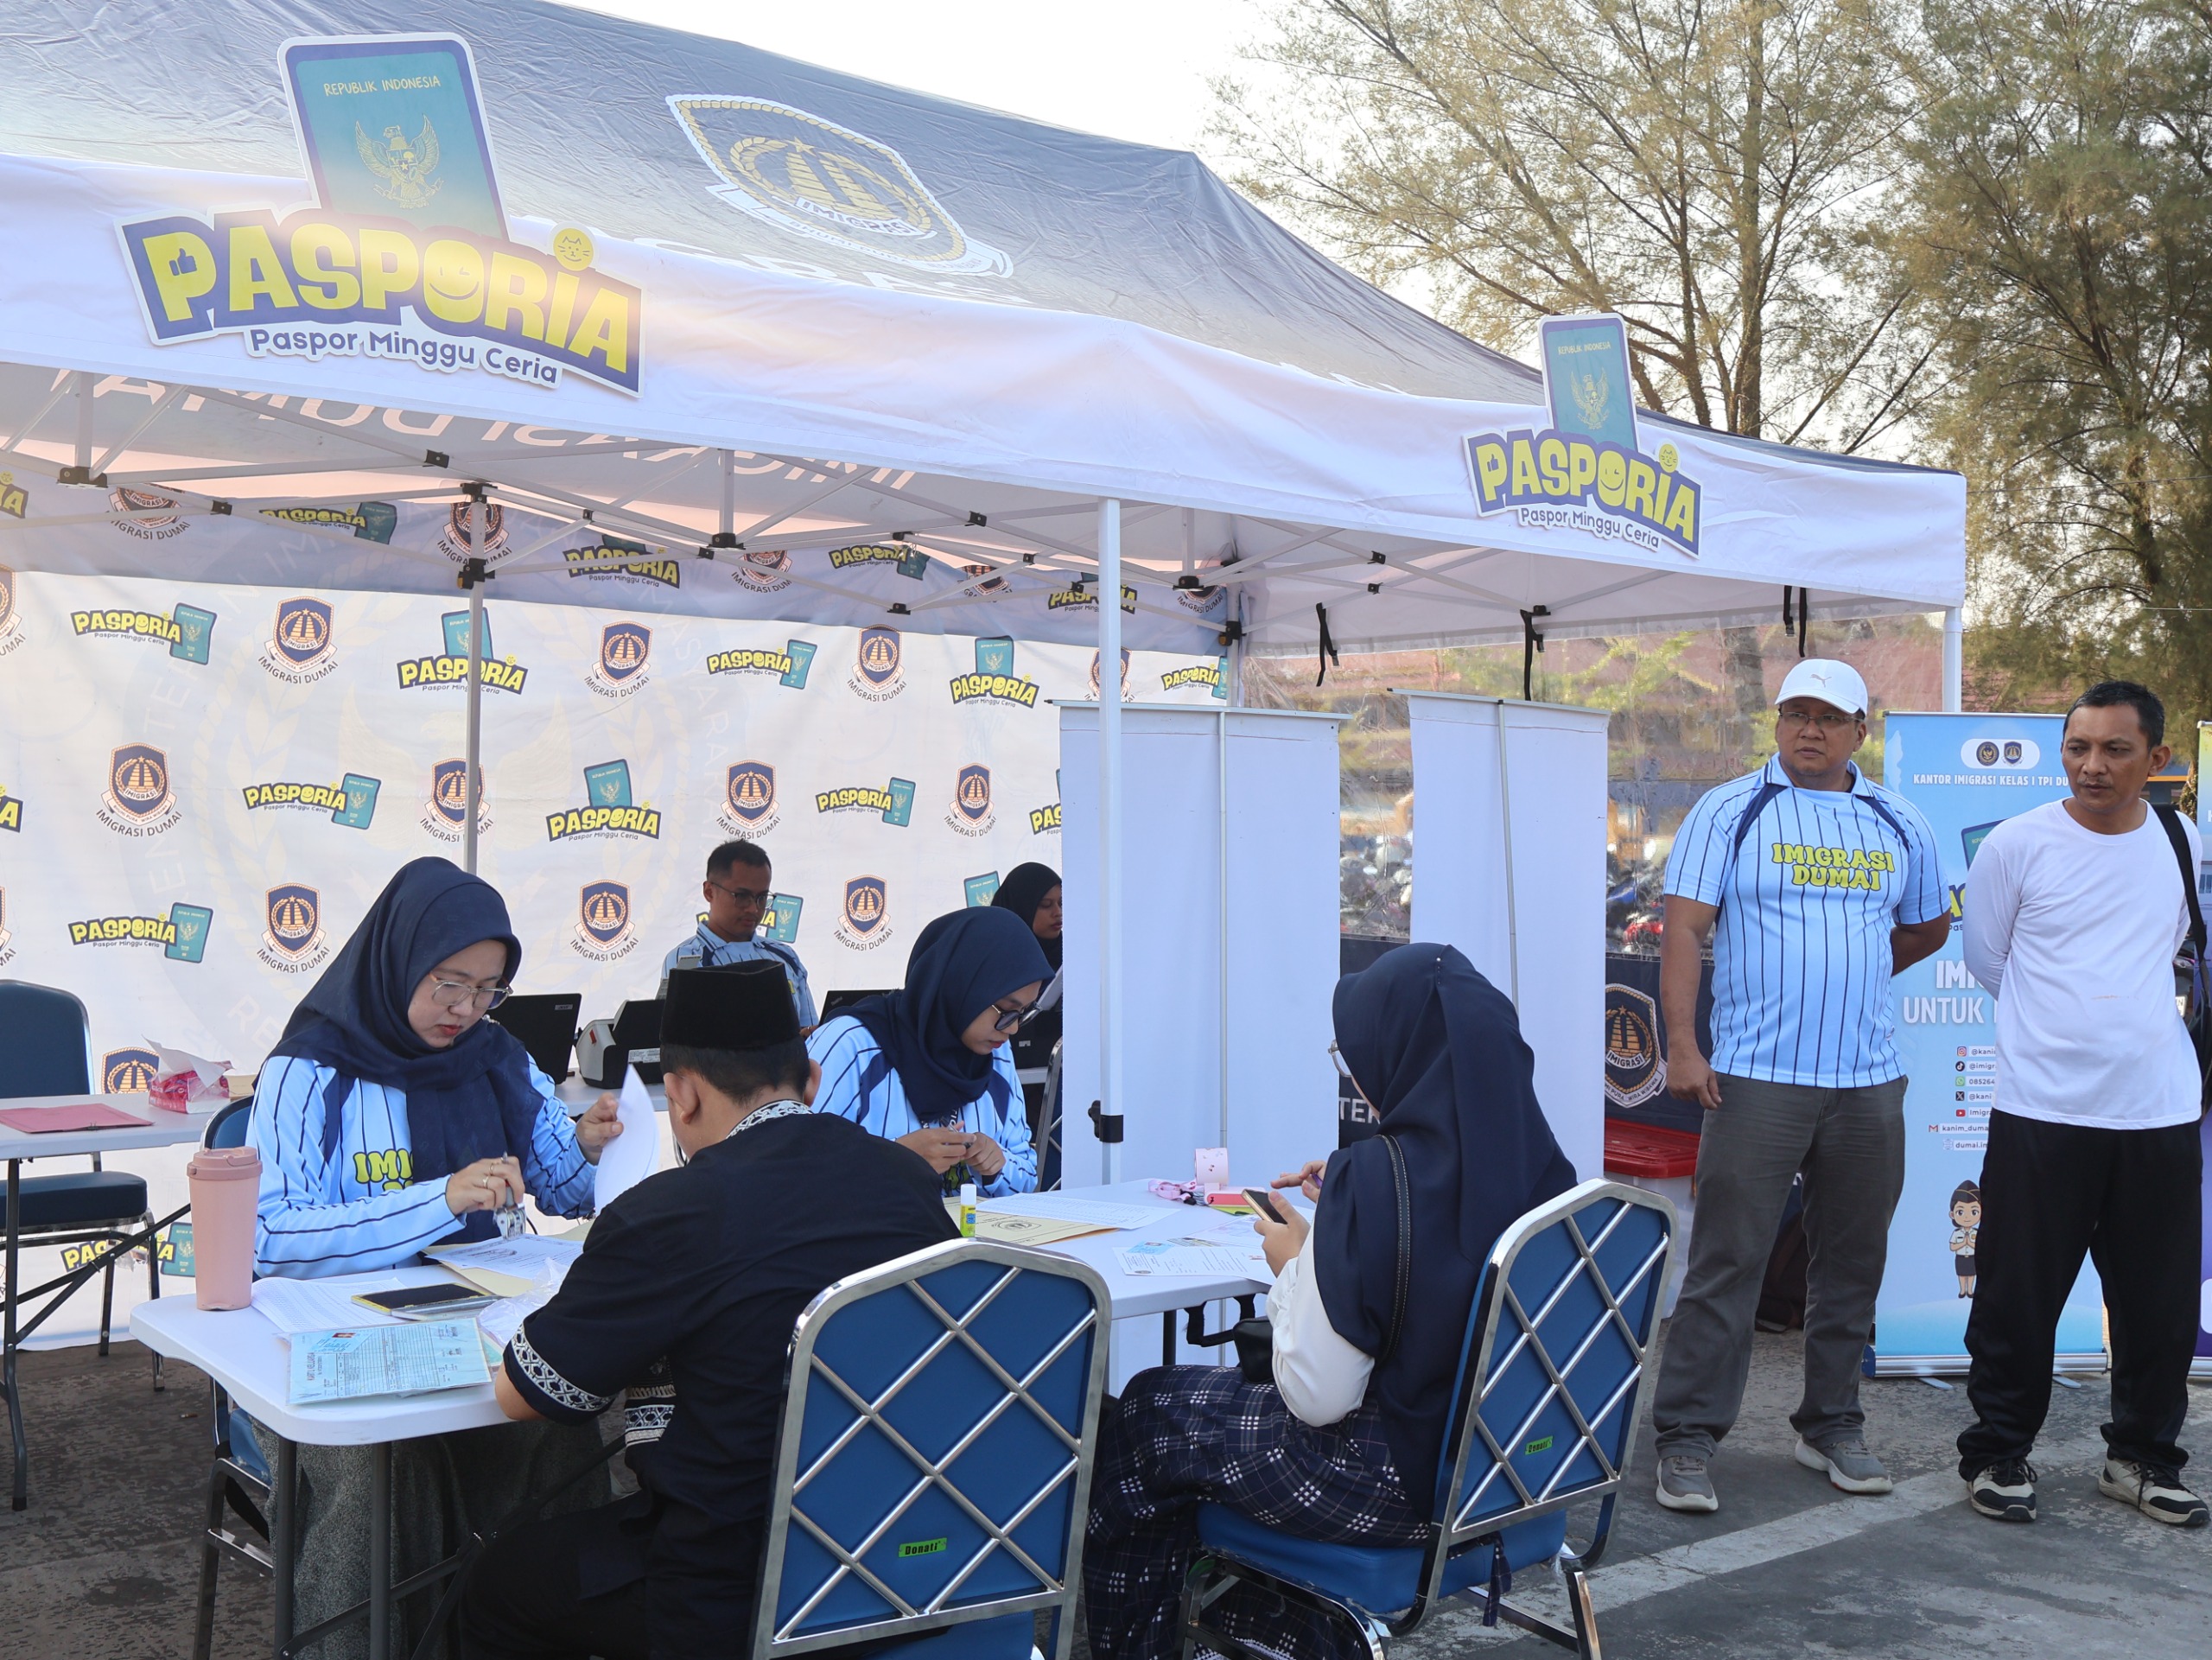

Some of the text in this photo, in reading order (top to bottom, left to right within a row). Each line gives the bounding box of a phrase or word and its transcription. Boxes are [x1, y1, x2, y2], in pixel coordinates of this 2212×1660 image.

[323, 74, 442, 97] REPUBLIK INDONESIA
[142, 223, 630, 374] PASPORIA
[251, 329, 558, 384] Paspor Minggu Ceria
[1558, 341, 1611, 355] REPUBLIK INDONESIA
[1476, 438, 1695, 542] PASPORIA
[156, 521, 190, 540] DUMAI
[1521, 507, 1659, 549] Paspor Minggu Ceria
[732, 571, 772, 594] IMIGRASI
[74, 611, 181, 642] PASPORIA
[121, 633, 146, 643] Minggu
[148, 637, 164, 646] Ceria
[288, 639, 316, 649] IMIGRASI
[258, 656, 338, 684] IMIGRASI DUMAI
[611, 660, 635, 670] IMIGRASI
[709, 650, 791, 673] PASPORIA
[868, 662, 889, 672] IMIGRASI
[584, 676, 618, 698] IMIGRASI
[620, 677, 650, 697] DUMAI
[952, 674, 1037, 704] PASPORIA
[1163, 665, 1221, 690] PASPORIA
[481, 685, 499, 695] Ceria
[847, 678, 880, 702] IMIGRASI
[881, 681, 907, 702] DUMAI
[1913, 773, 1951, 785] KANTOR
[1954, 774, 1996, 785] IMIGRASI
[1999, 775, 2029, 785] KELAS
[2031, 776, 2035, 785] I
[2037, 776, 2053, 786] TPI
[125, 789, 156, 799] IMIGRASI
[246, 782, 346, 811] PASPORIA
[739, 798, 764, 810] IMIGRASI
[819, 787, 892, 811] PASPORIA
[96, 810, 182, 837] IMIGRASI DUMAI
[420, 818, 460, 843] IMIGRASI
[550, 807, 659, 837] PASPORIA
[716, 817, 754, 840] IMIGRASI
[756, 816, 780, 838] DUMAI
[944, 815, 977, 836] IMIGRASI
[979, 816, 996, 836] DUMAI
[569, 833, 593, 842] Paspor
[620, 831, 639, 840] Ceria
[1771, 842, 1895, 874] IMIGRASI
[1791, 864, 1882, 891] DUMAI
[592, 919, 618, 930] IMIGRASI
[855, 912, 875, 920] IMIGRASI
[72, 918, 175, 944] PASPORIA
[280, 927, 306, 937] IMIGRASI
[834, 929, 867, 951] IMIGRASI
[868, 928, 893, 951] DUMAI
[257, 946, 330, 974] IMIGRASI DUMAI
[570, 938, 639, 962] IMIGRASI DUMAI
[1903, 996, 1985, 1024] UNTUK
[1607, 1053, 1643, 1067] IMIGRASI
[1611, 1089, 1624, 1100] PURA
